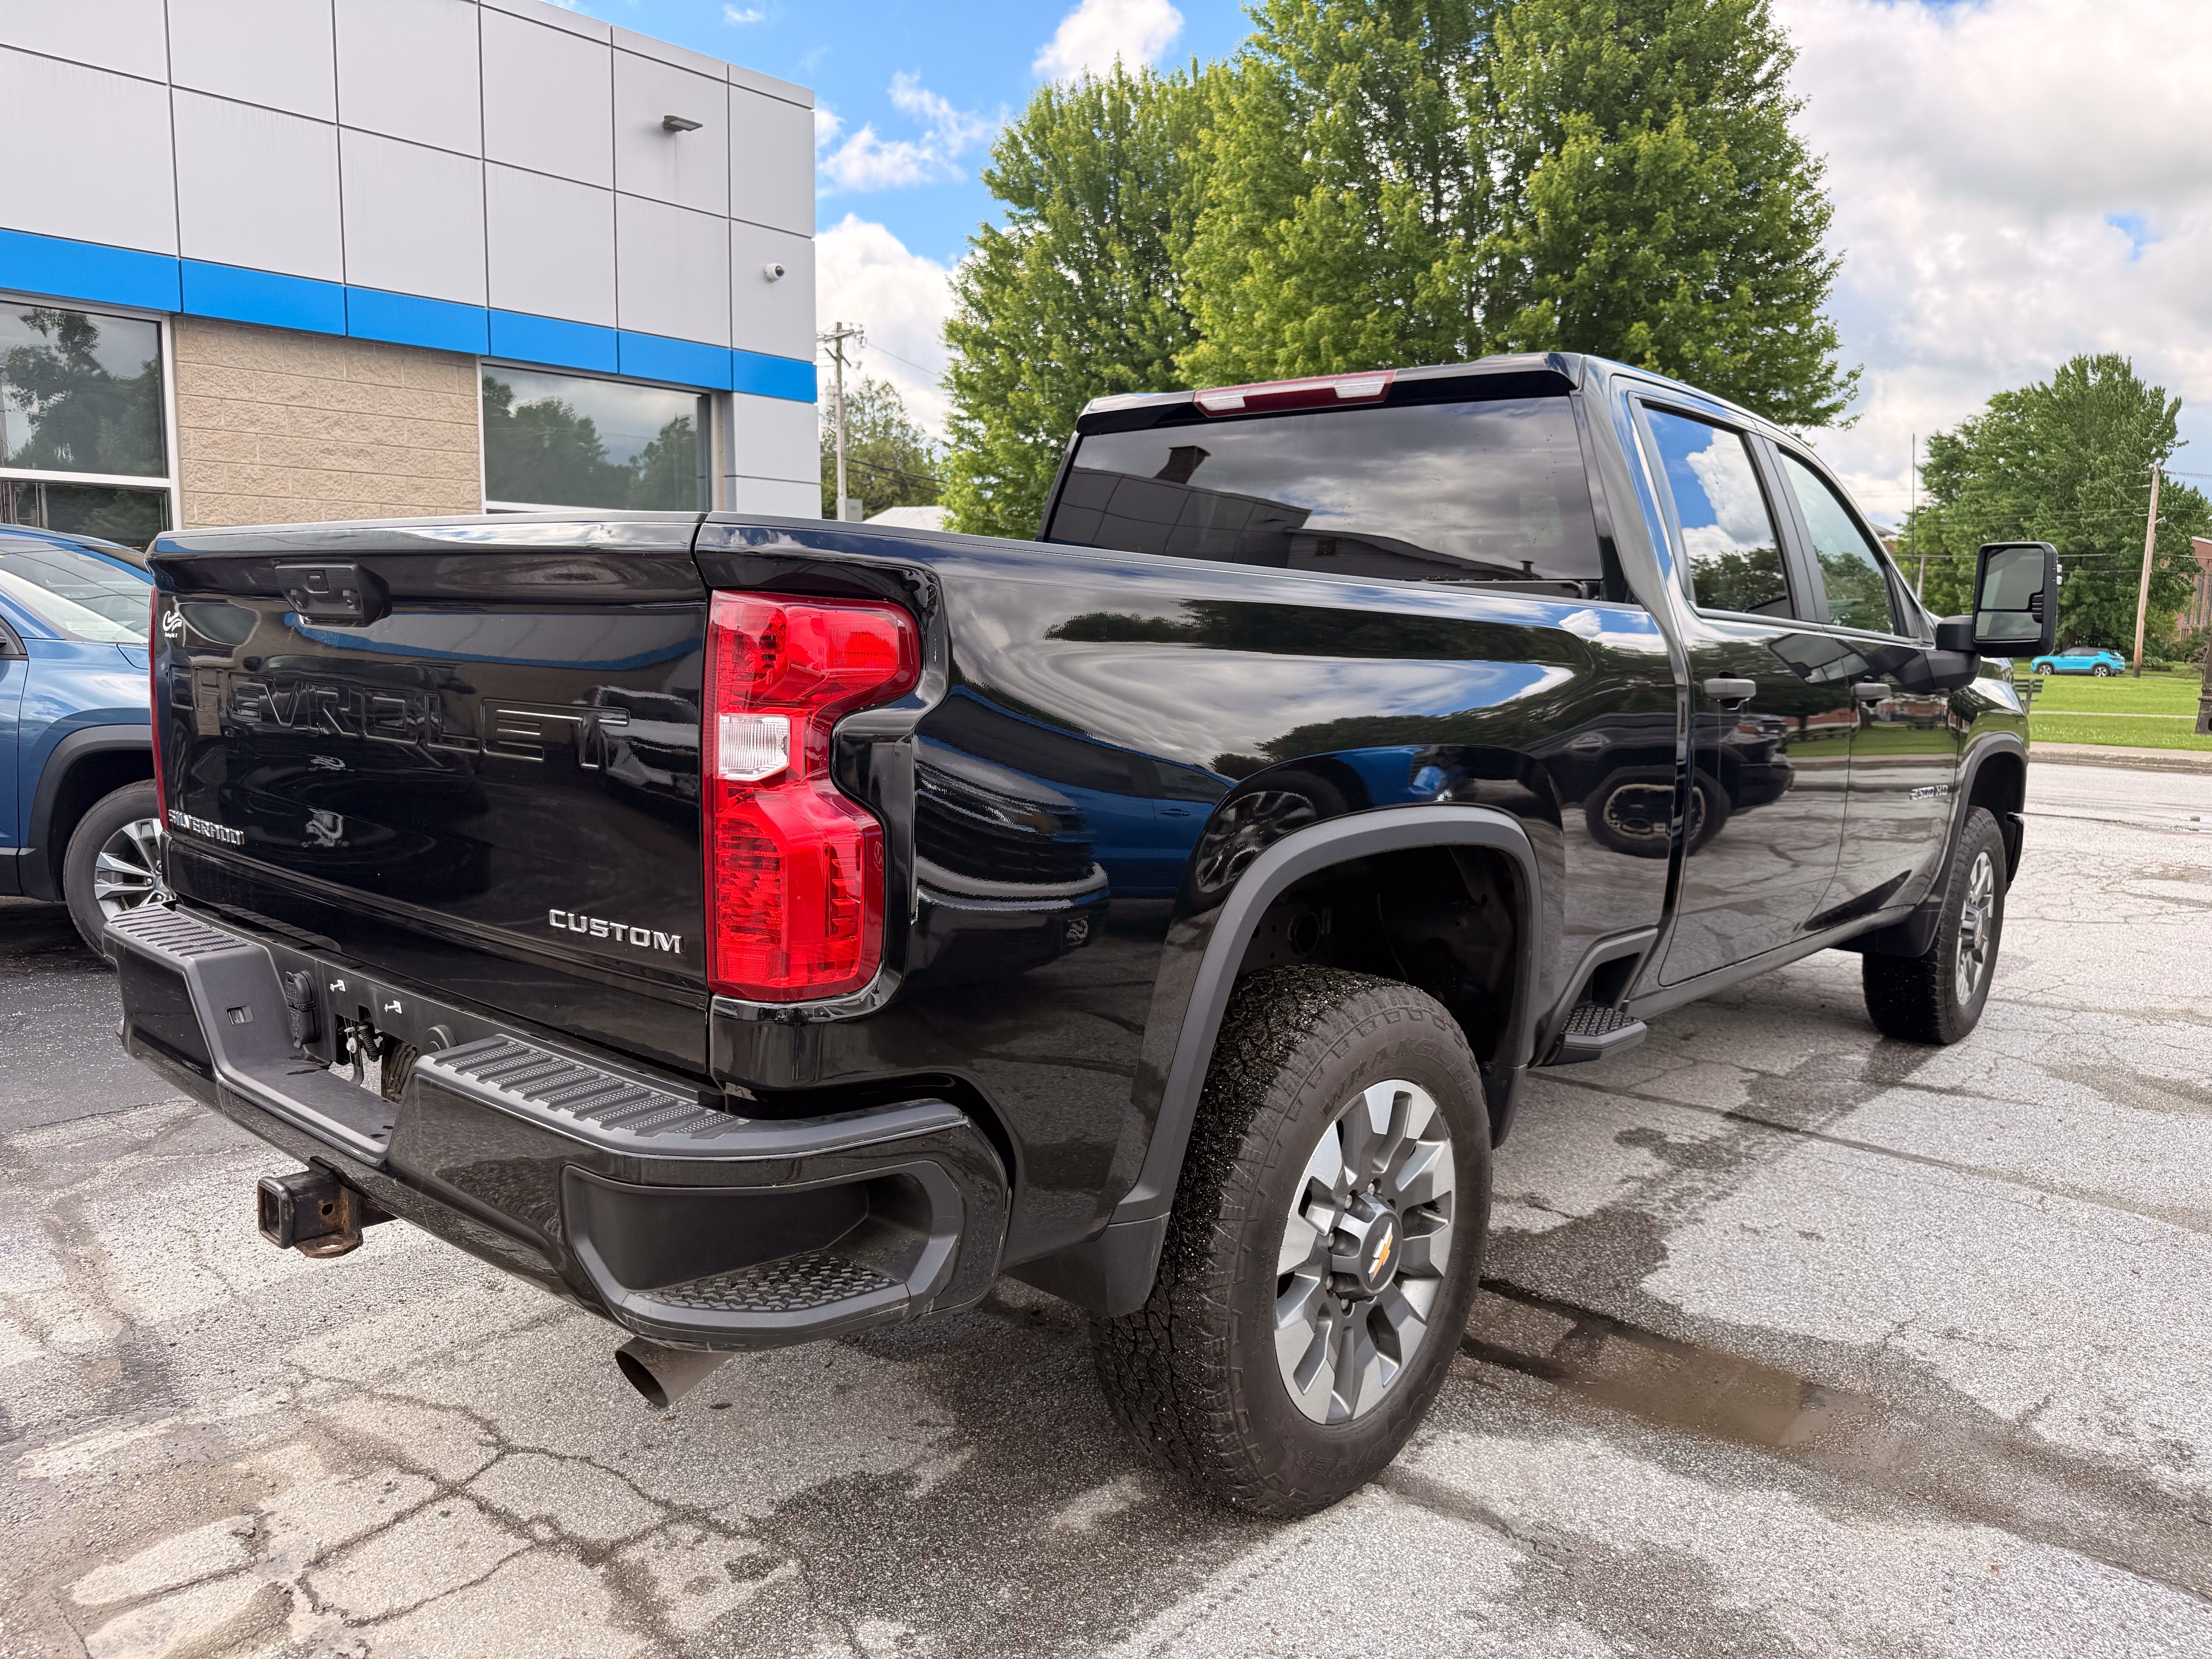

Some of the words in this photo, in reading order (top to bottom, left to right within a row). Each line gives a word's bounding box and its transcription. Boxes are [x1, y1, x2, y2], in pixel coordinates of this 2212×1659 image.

[169, 664, 630, 769] CHEVROLET
[1910, 786, 1934, 800] 2500
[1936, 785, 1948, 796] HD
[168, 809, 246, 845] SILVERADO
[549, 909, 684, 954] CUSTOM
[1321, 1038, 1475, 1119] WRANGLER
